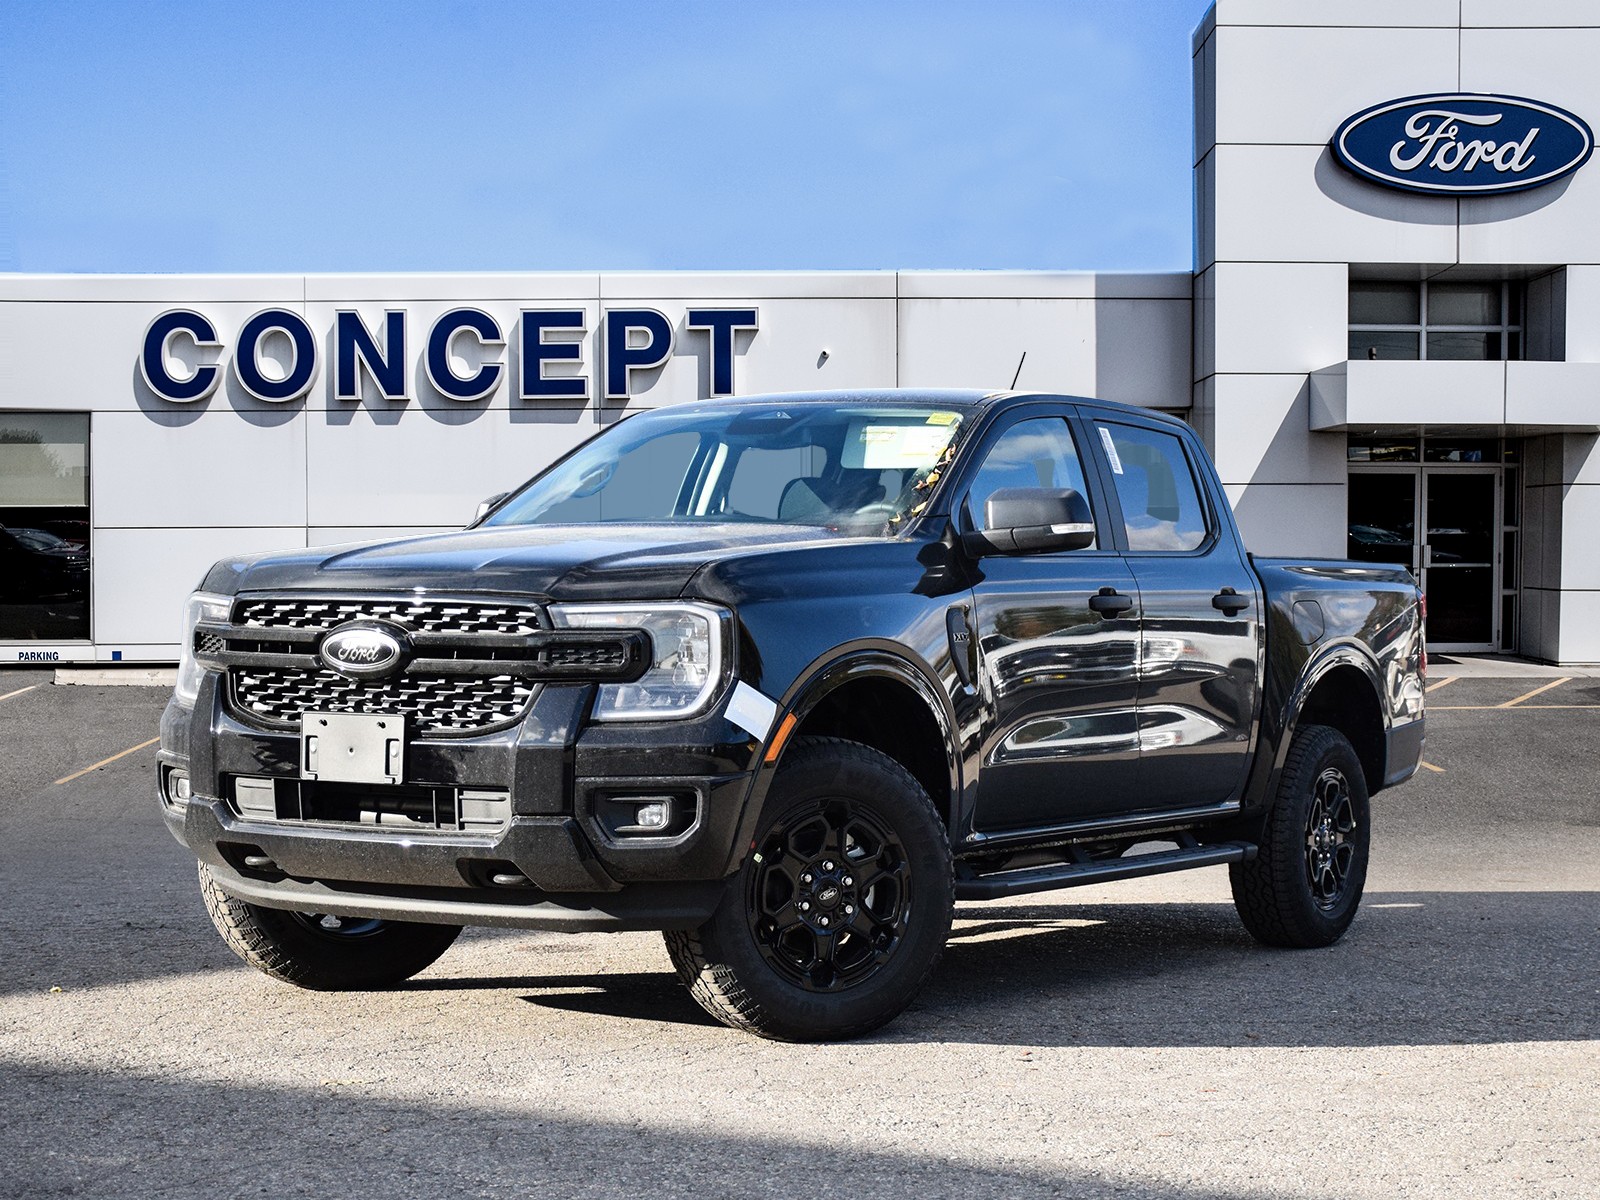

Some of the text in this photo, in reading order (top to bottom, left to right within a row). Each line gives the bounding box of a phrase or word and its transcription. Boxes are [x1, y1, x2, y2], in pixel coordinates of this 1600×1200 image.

[1389, 109, 1541, 172] Ford
[139, 306, 759, 402] CONCEPT
[18, 651, 59, 661] PARKING
